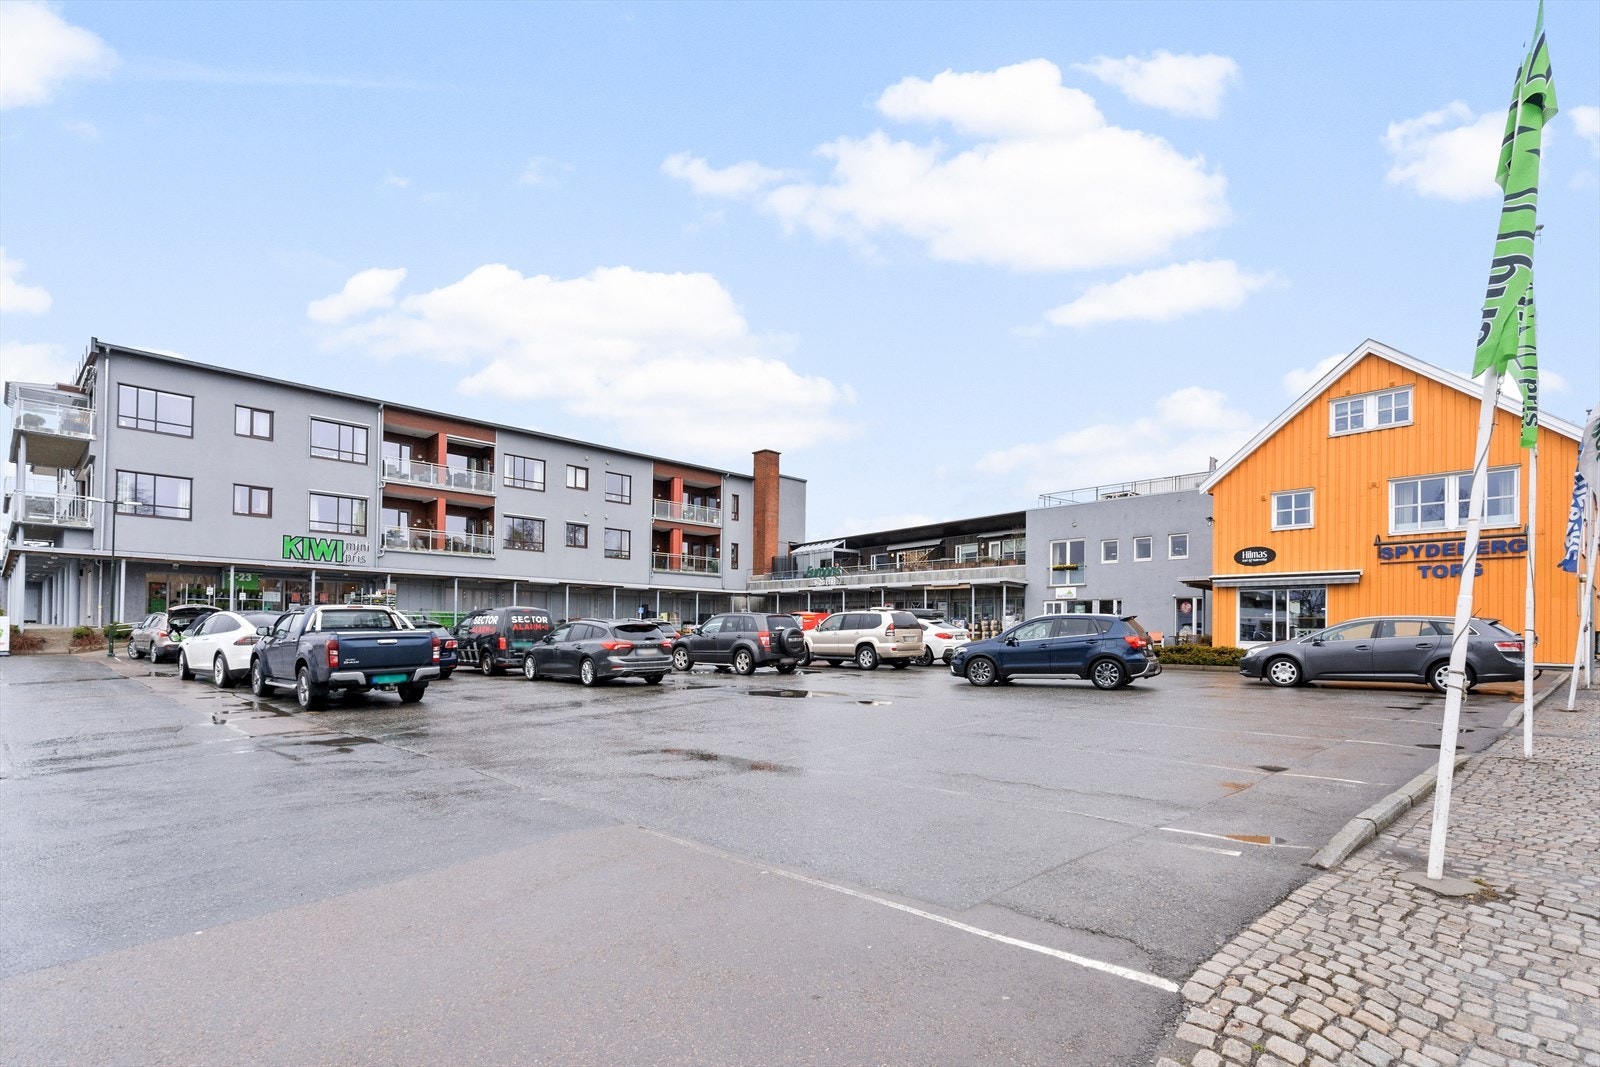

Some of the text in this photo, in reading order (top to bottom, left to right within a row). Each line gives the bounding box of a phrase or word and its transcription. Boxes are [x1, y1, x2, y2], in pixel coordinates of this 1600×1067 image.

[282, 534, 344, 563] KIWI
[345, 541, 370, 552] mini
[345, 551, 367, 564] pris
[1242, 550, 1268, 559] Hilmas
[473, 615, 499, 625] SECTOR
[511, 615, 548, 624] SECTOR
[512, 623, 541, 631] ALARM
